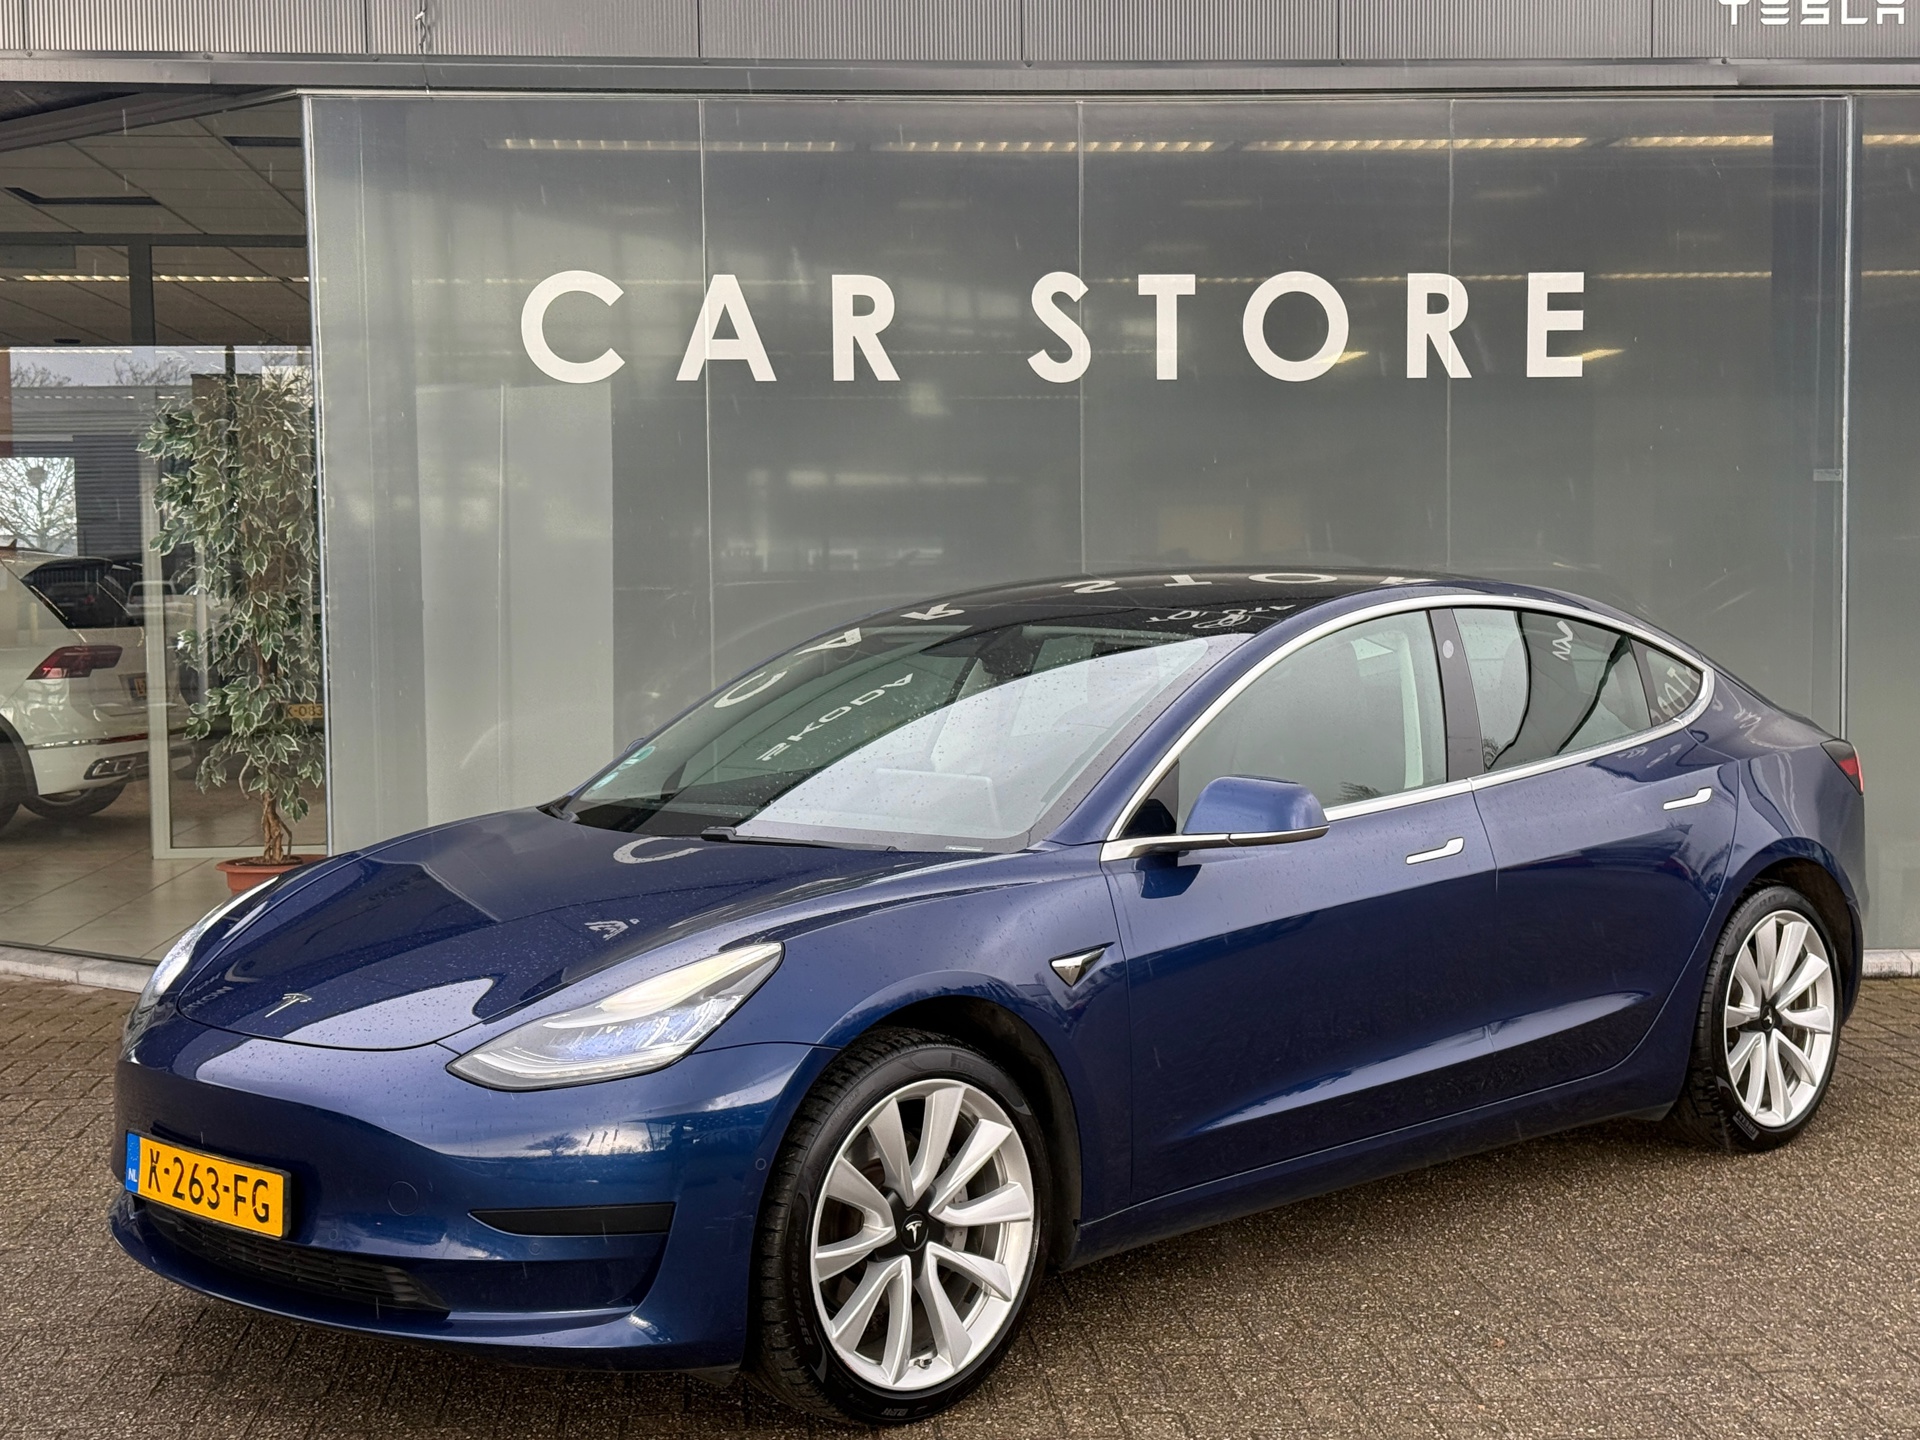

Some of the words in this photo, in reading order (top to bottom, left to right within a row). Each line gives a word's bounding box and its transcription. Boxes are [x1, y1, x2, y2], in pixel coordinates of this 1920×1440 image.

[1718, 0, 1905, 25] TESLA
[520, 269, 901, 384] CAR
[1027, 269, 1585, 383] STORE
[128, 1167, 138, 1182] NL
[148, 1148, 270, 1223] K-263-FG
